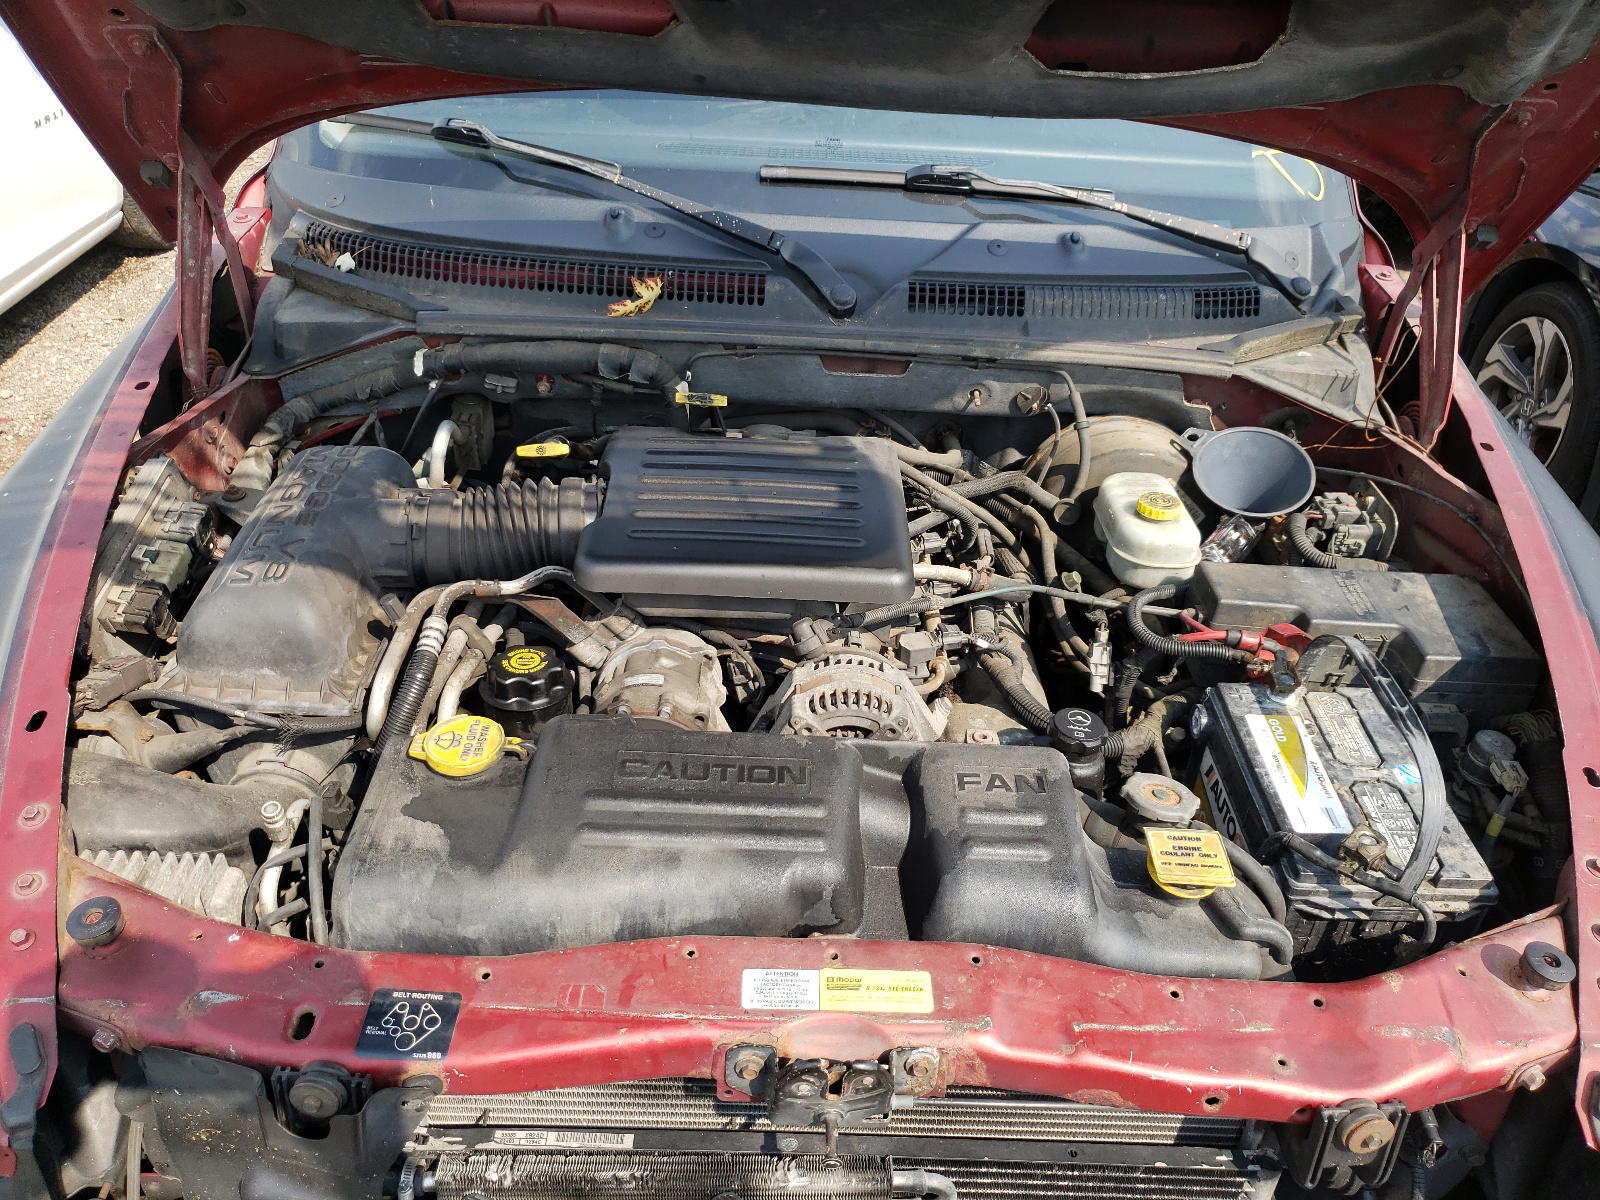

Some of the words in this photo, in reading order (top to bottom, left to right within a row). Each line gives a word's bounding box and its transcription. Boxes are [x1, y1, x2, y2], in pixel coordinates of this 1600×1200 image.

[295, 445, 362, 527] DODGE
[228, 448, 330, 586] MAGNUM
[262, 538, 306, 583] V8
[466, 720, 480, 741] FLUID
[472, 724, 490, 757] WASHER
[1268, 717, 1288, 743] GOLD
[617, 758, 808, 785] CAUTION
[956, 772, 1047, 794] FAN
[1160, 850, 1194, 858] COOLANT
[392, 991, 411, 999] BELT
[412, 992, 444, 1000] ROUTING
